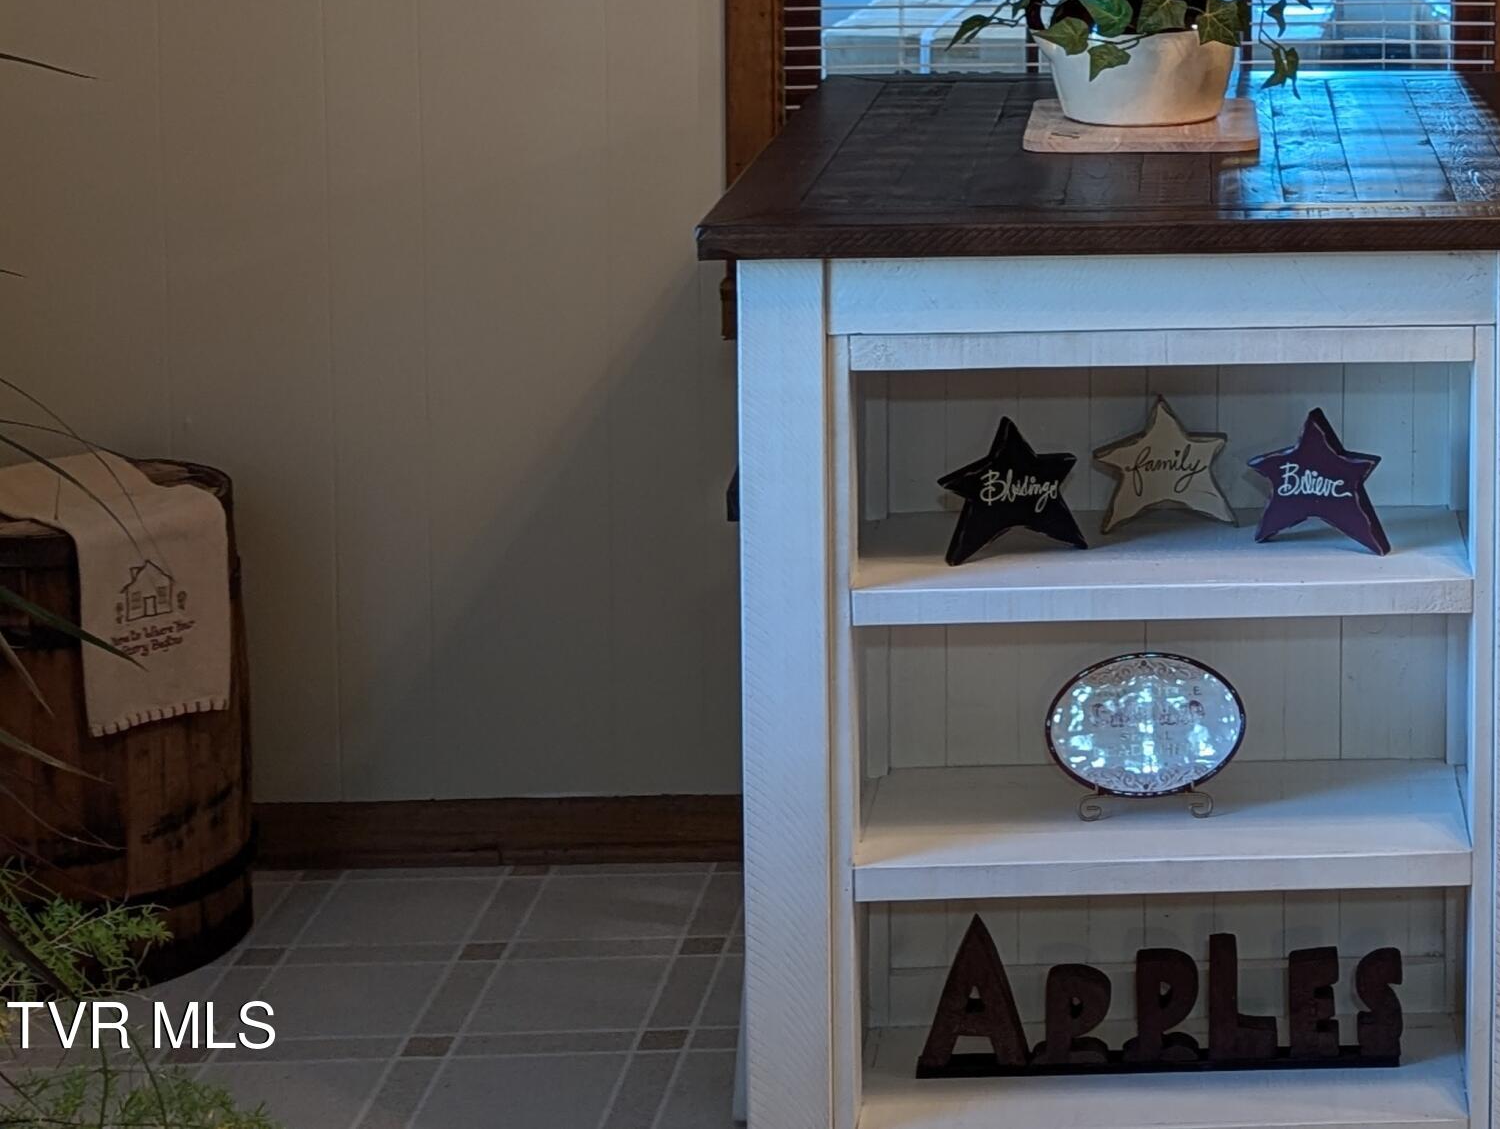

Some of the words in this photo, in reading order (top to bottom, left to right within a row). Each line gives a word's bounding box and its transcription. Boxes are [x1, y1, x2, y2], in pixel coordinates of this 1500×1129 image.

[1125, 444, 1207, 496] family
[1278, 462, 1352, 497] Believe
[922, 913, 1403, 1067] APPLES
